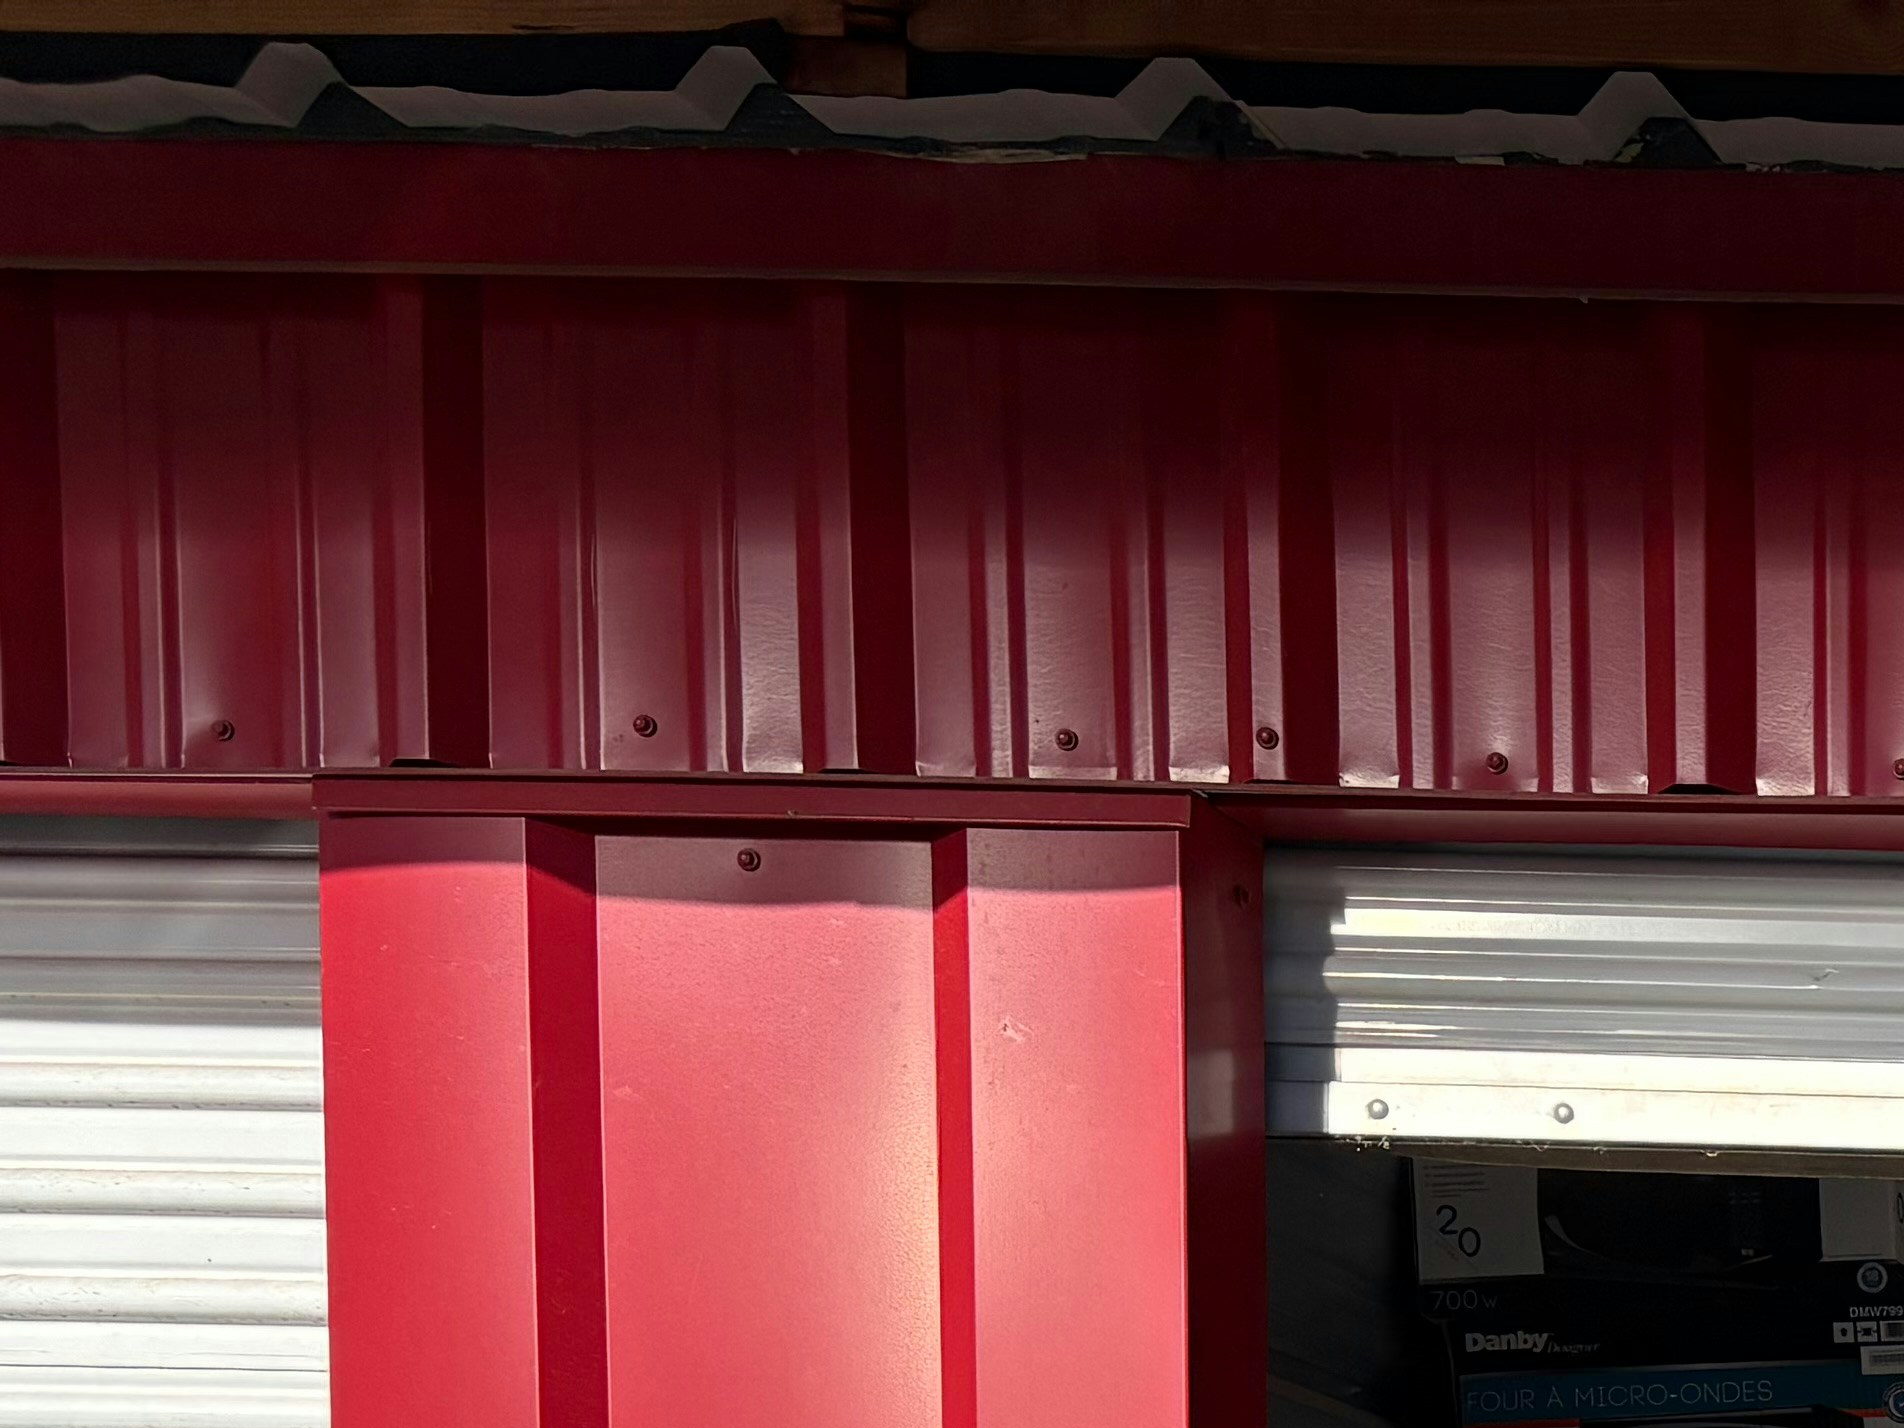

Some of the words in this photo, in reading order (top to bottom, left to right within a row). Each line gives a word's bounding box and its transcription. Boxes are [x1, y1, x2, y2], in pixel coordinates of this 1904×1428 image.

[1465, 1330, 1551, 1353] Danby
[1466, 1388, 1535, 1412] FOUR
[1575, 1380, 1773, 1408] MICRO-ONDES
